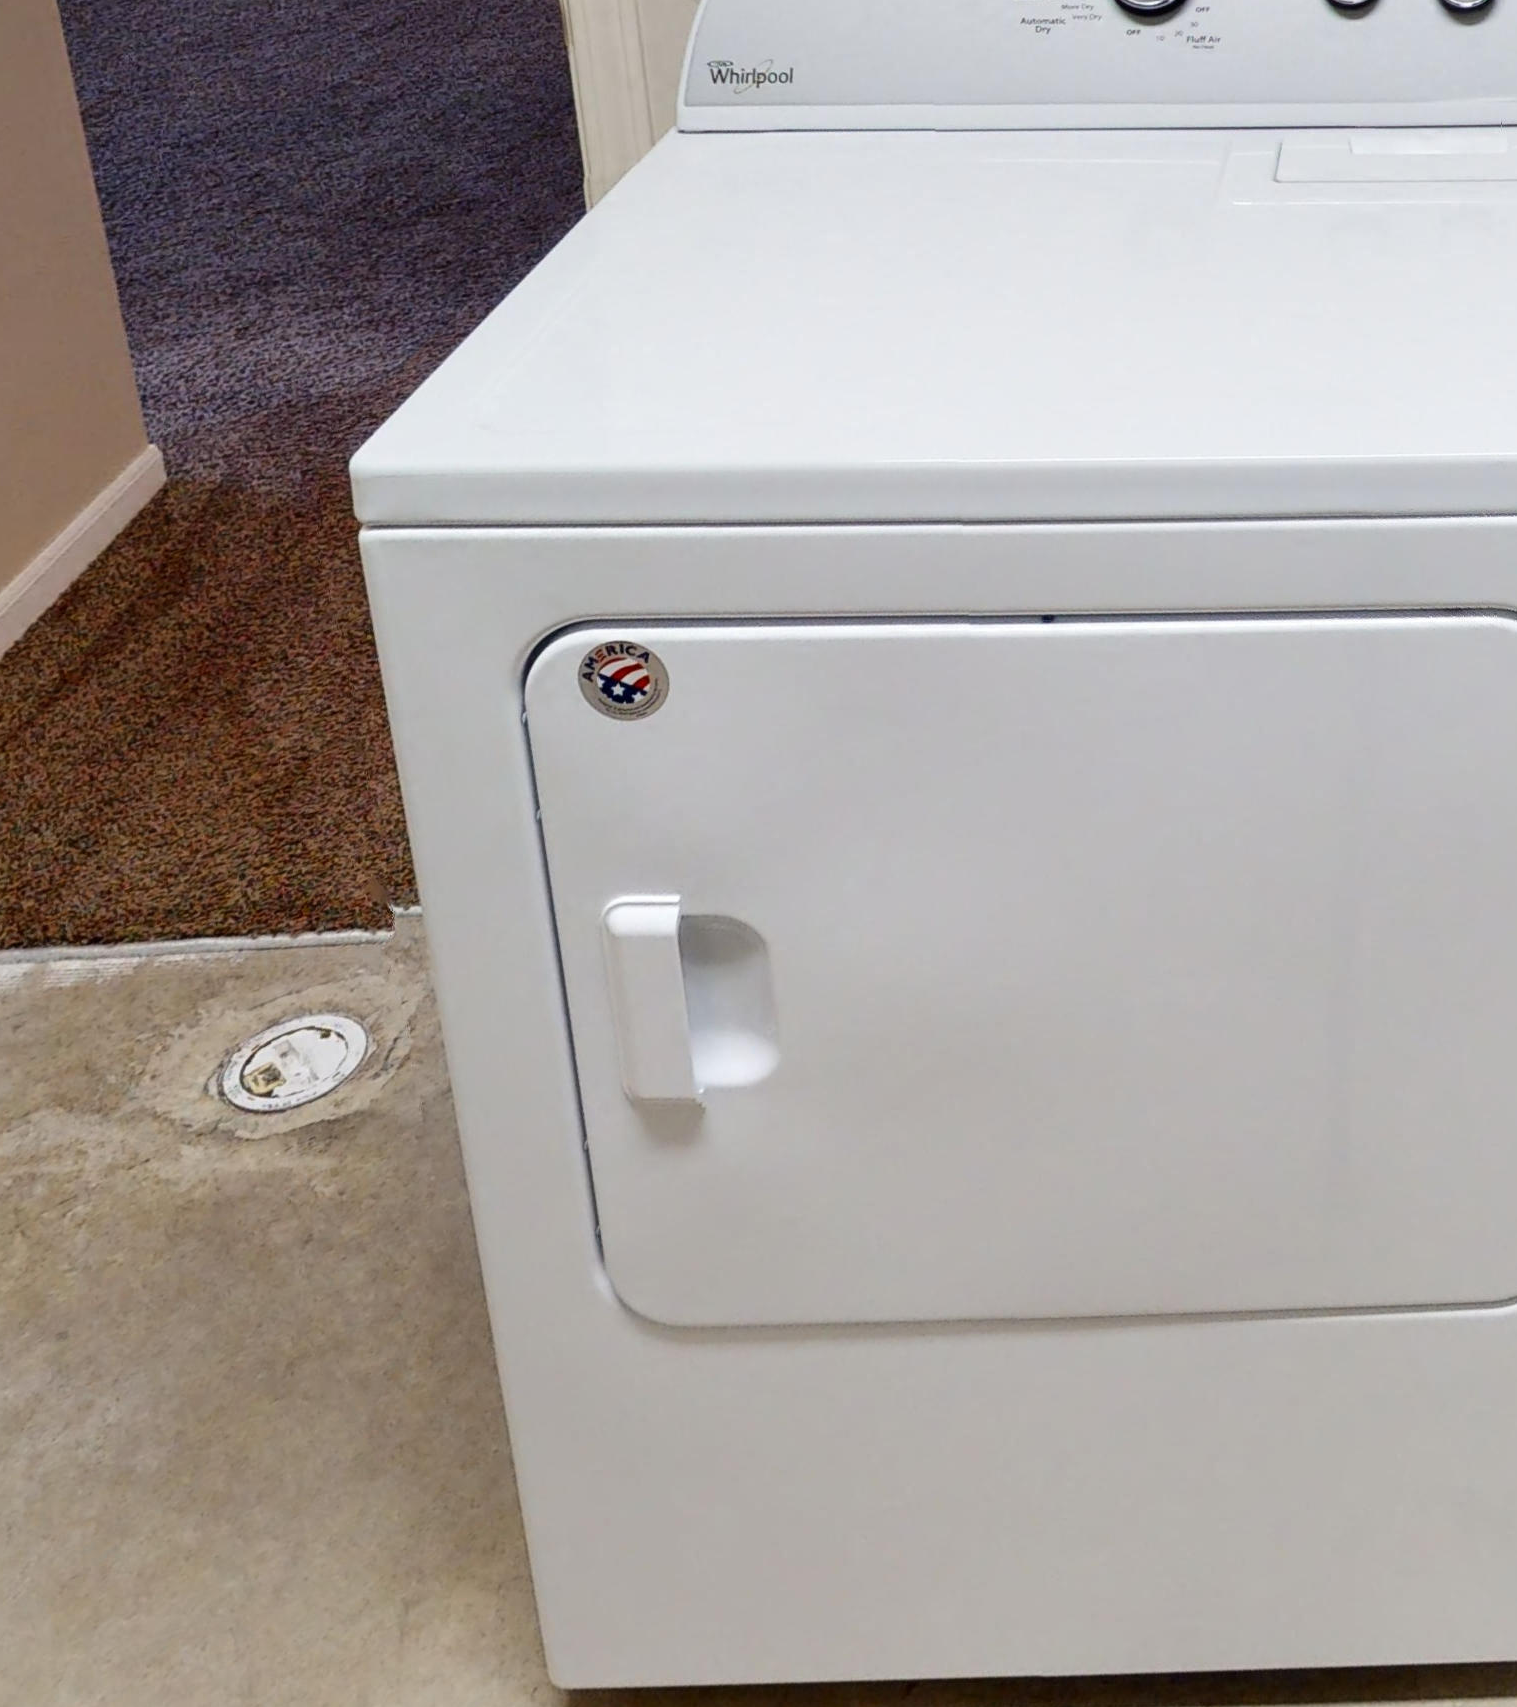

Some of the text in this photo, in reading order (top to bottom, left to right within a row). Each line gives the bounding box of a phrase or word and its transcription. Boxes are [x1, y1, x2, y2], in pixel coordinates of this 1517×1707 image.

[1020, 17, 1066, 25] Automatic
[1035, 26, 1051, 34] Dry
[709, 66, 794, 88] Whirlpool
[581, 643, 651, 683] AMERICA
